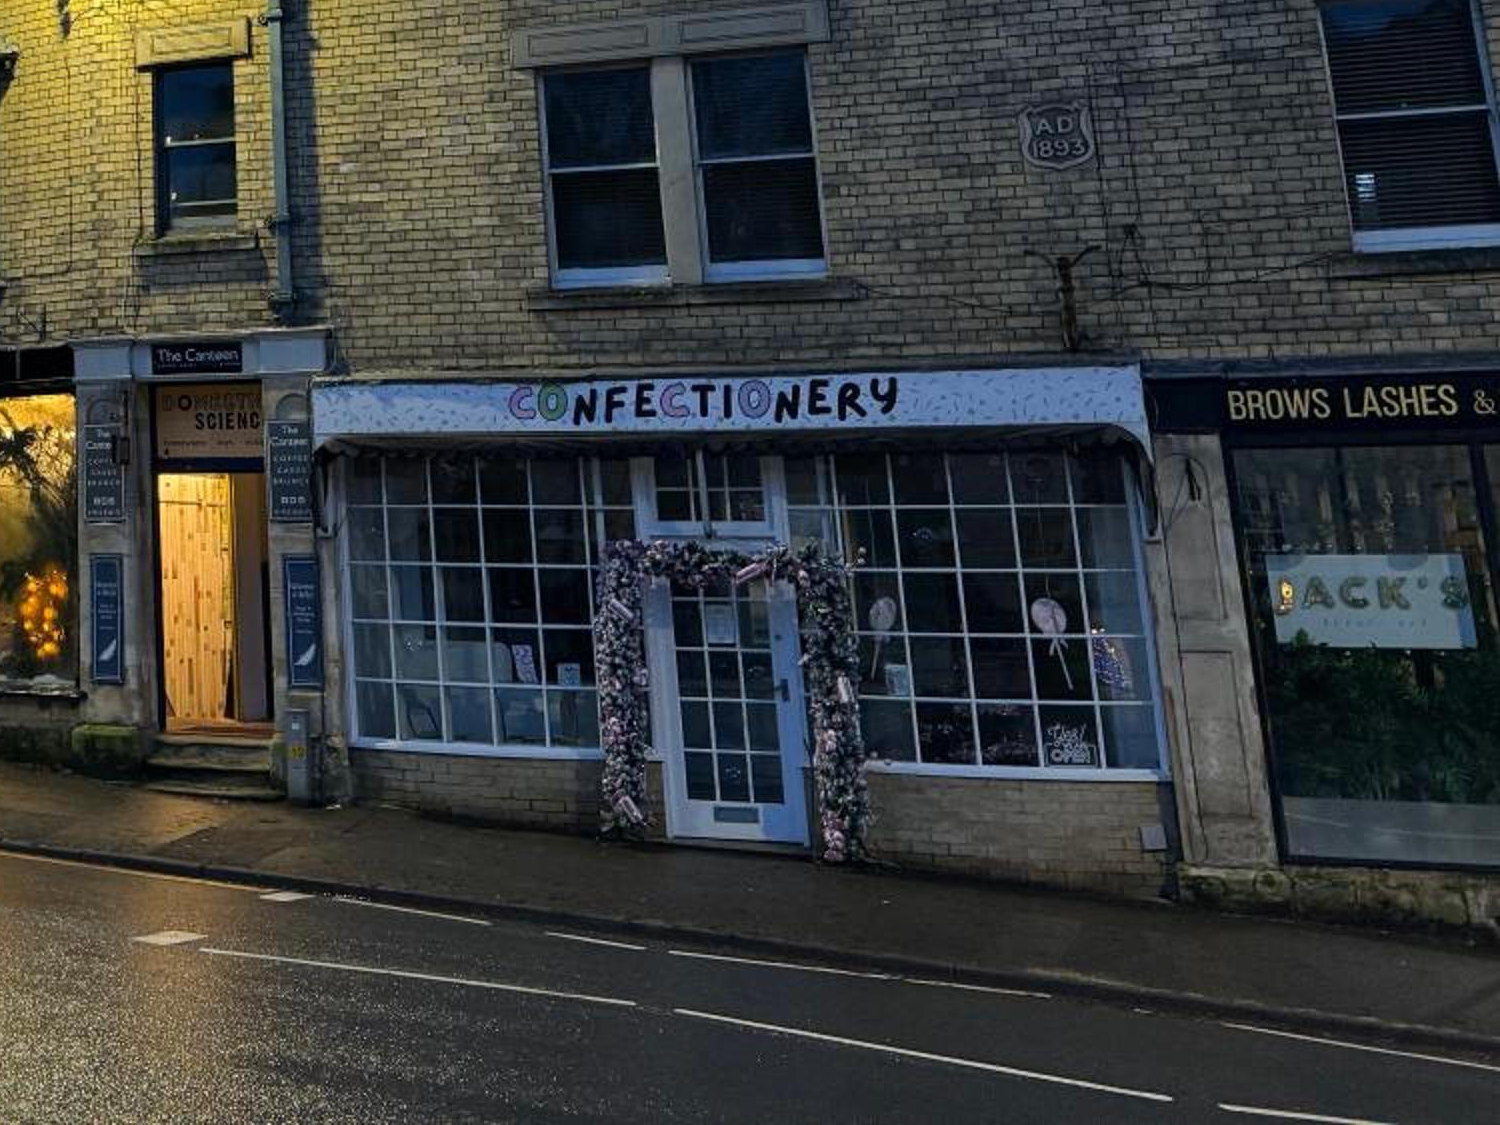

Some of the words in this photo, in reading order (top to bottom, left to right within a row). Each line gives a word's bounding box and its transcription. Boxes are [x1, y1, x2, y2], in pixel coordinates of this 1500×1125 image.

[1032, 139, 1086, 157] 1893
[157, 348, 182, 362] The
[185, 348, 239, 362] Canteen
[508, 377, 898, 425] CONFECTIONERY
[1227, 387, 1332, 421] BROWS
[1343, 383, 1459, 419] LASHES
[1473, 389, 1496, 415] &
